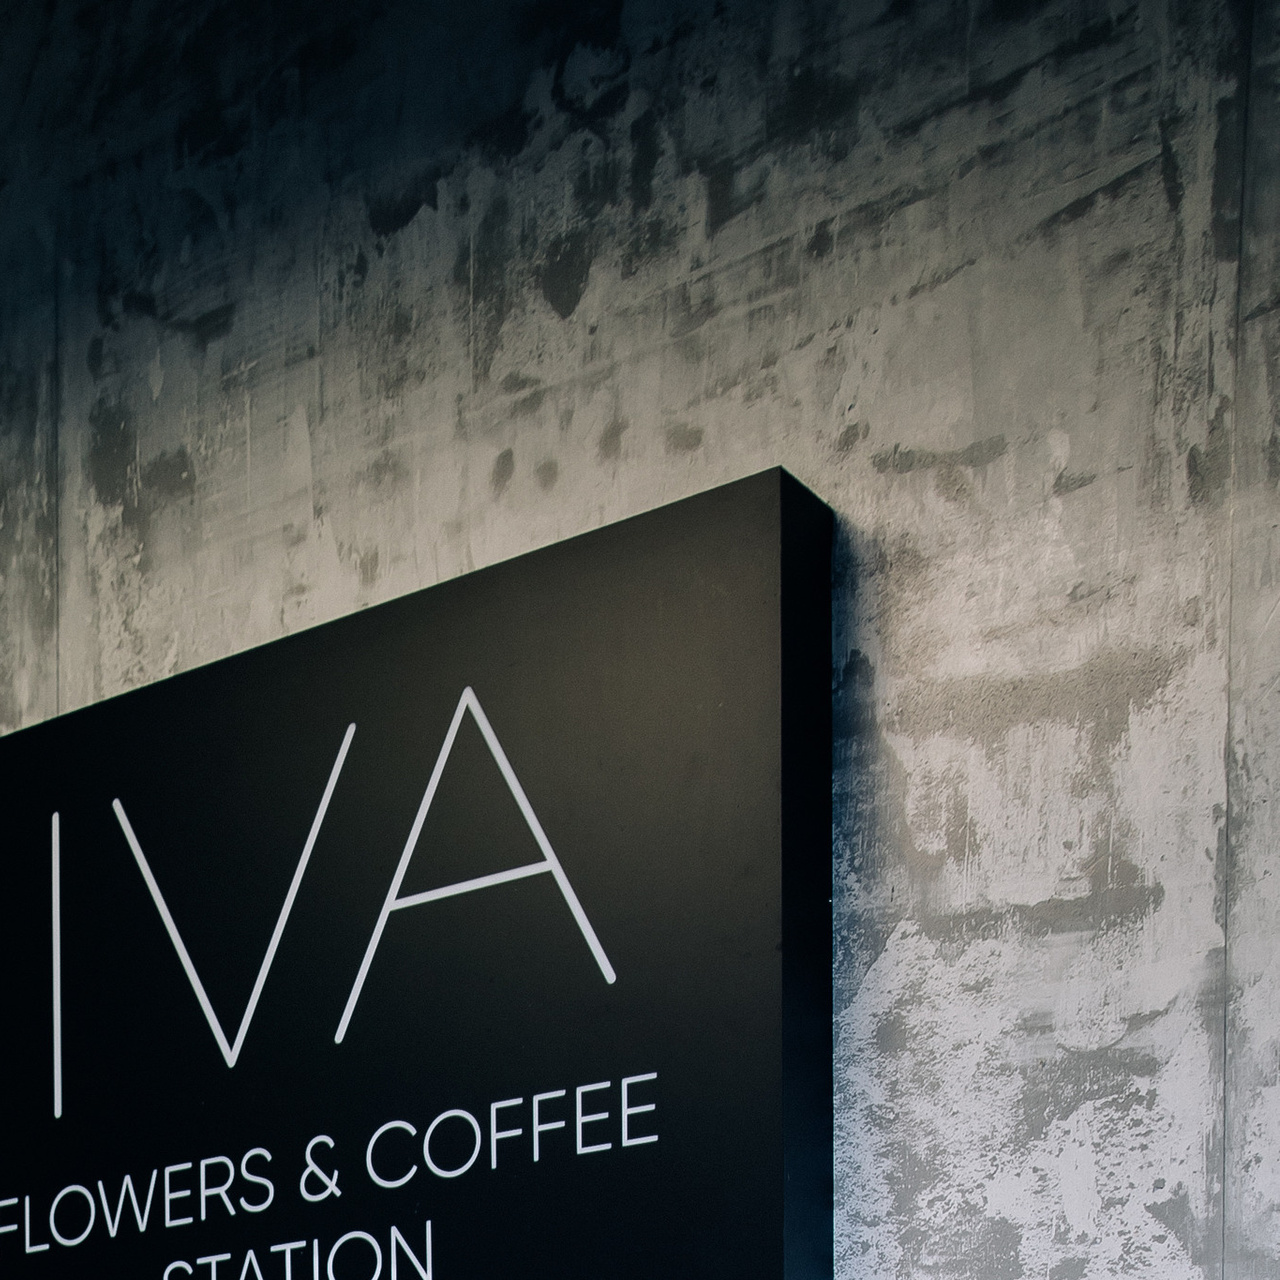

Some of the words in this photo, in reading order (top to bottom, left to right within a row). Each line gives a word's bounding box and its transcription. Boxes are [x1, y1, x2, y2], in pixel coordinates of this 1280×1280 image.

[51, 685, 618, 1119] IVA
[299, 1134, 343, 1202] &
[365, 1072, 660, 1189] COFFEE
